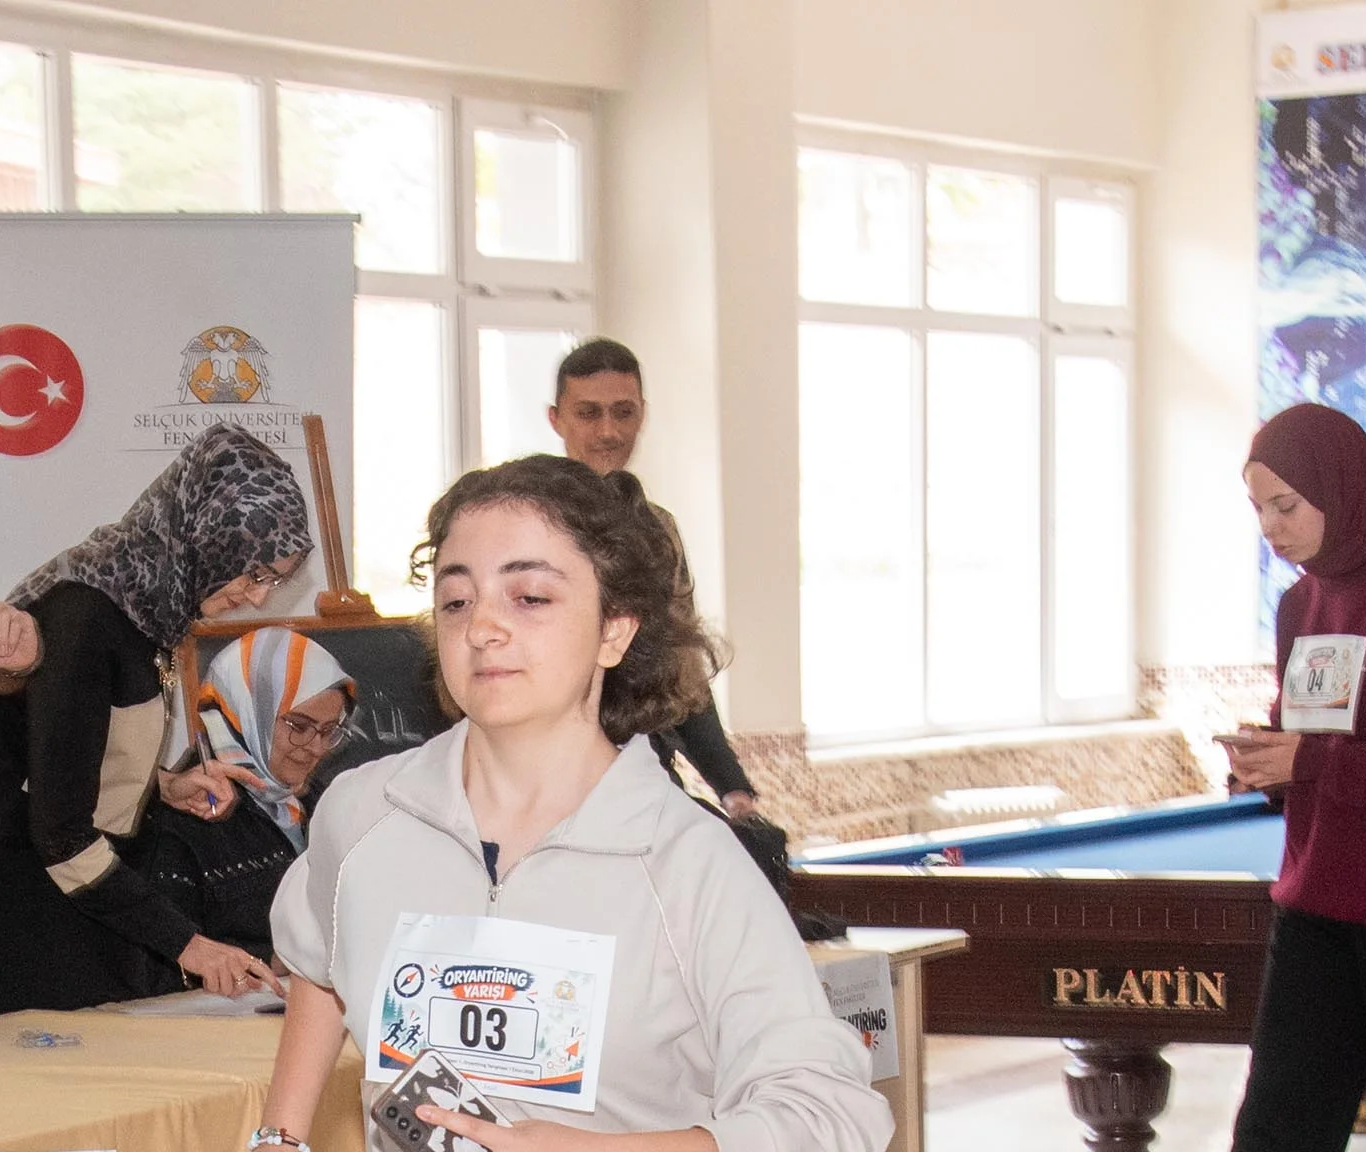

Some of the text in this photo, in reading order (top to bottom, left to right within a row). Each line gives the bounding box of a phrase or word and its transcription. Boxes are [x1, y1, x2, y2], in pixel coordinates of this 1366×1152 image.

[134, 410, 314, 430] SELÇUK ÜNİVERSİTE
[1307, 668, 1324, 692] 04
[444, 967, 528, 987] ORYANTİRİNG
[1052, 965, 1226, 1010] PLATİN
[463, 984, 505, 999] YARIŞI
[460, 1004, 508, 1052] 03
